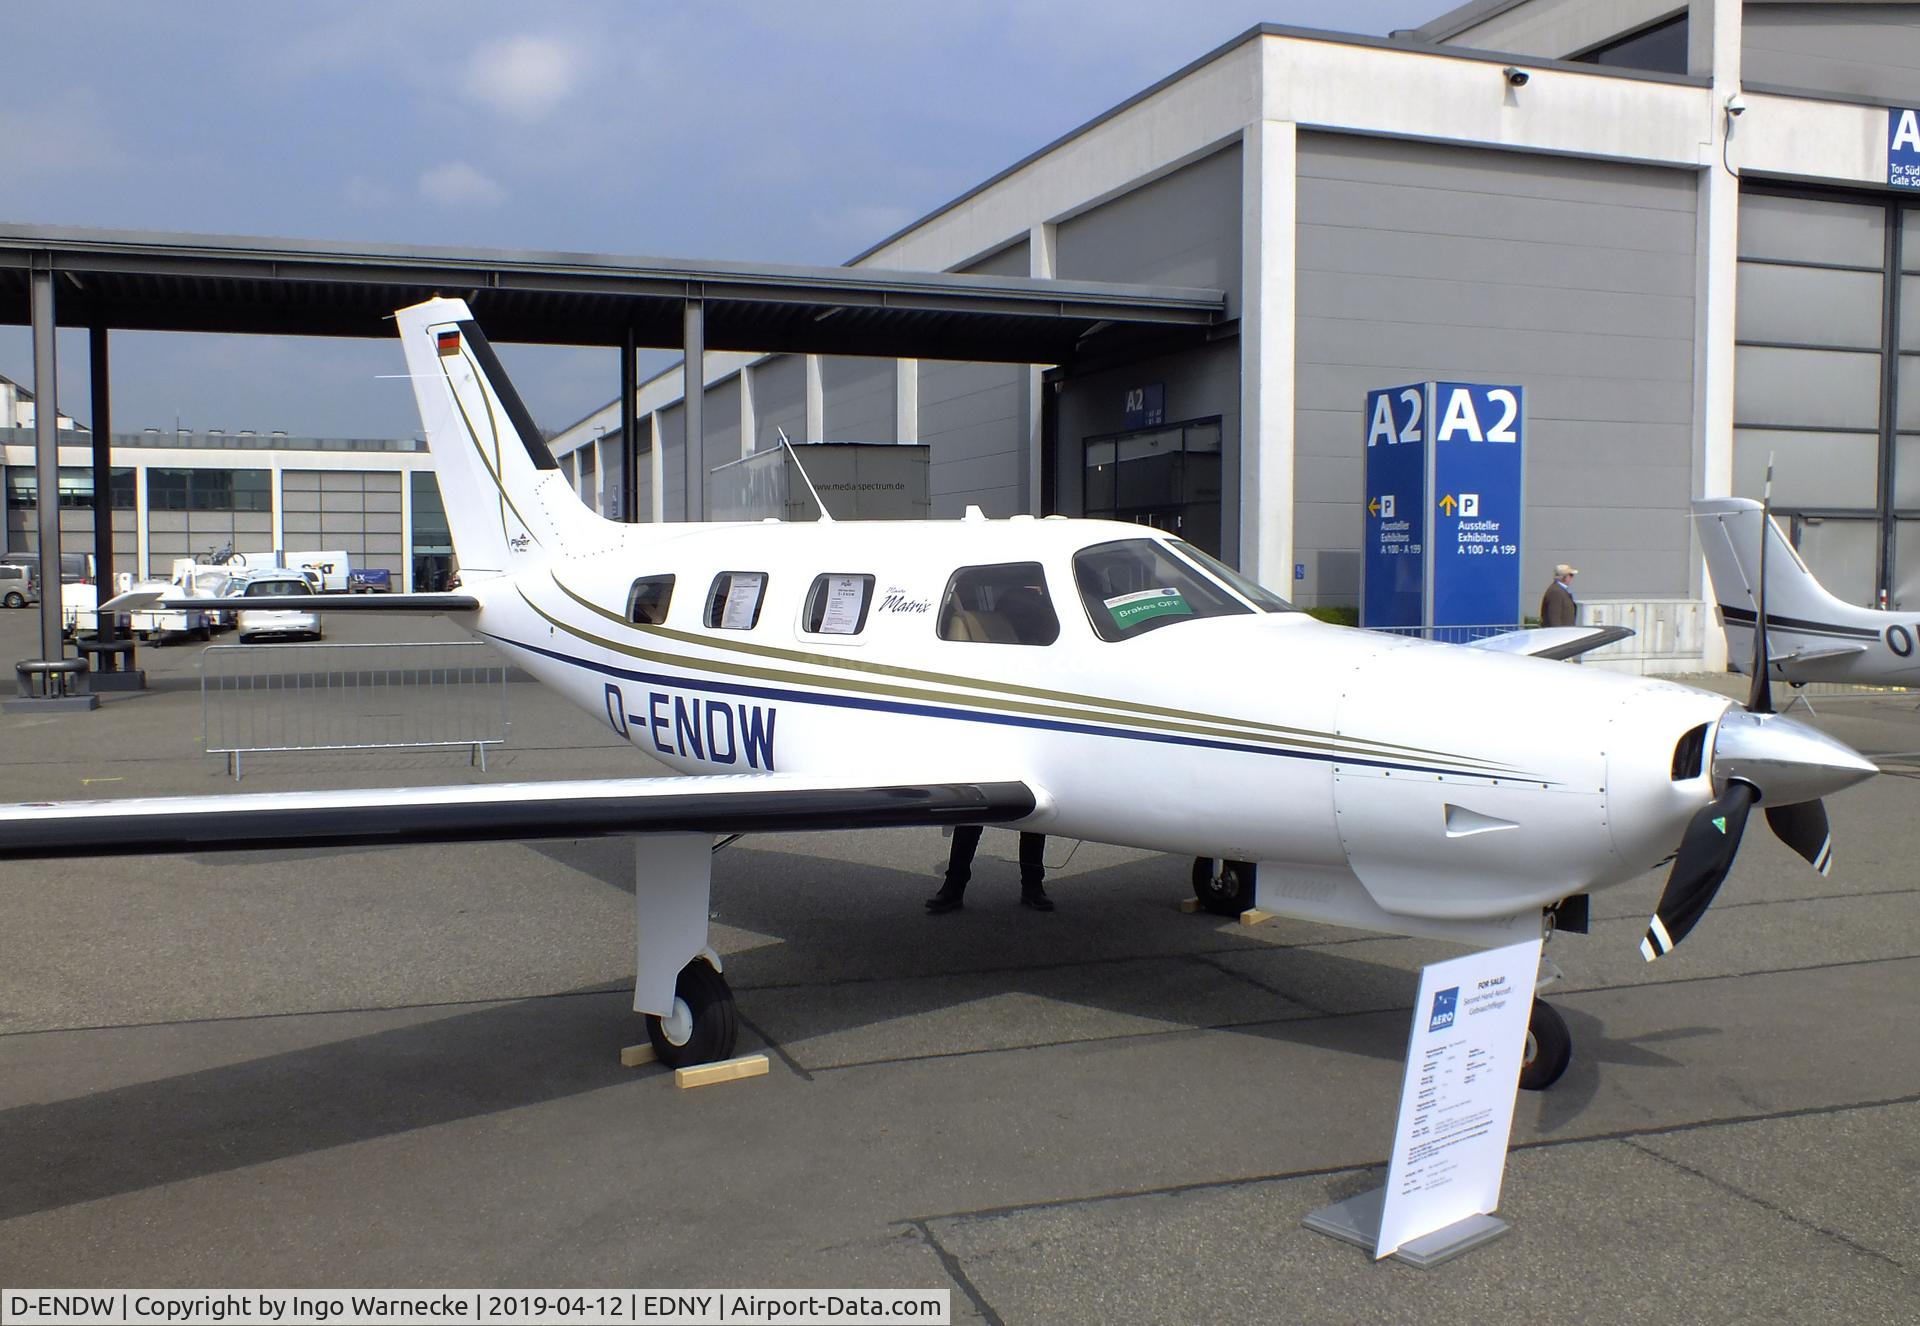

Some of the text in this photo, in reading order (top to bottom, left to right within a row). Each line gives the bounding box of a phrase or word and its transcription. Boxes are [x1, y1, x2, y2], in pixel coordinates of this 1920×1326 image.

[1891, 164, 1920, 176] Tor Süd
[1891, 175, 1909, 185] Gate
[1126, 388, 1144, 412] A2
[1368, 389, 1422, 447] A2
[1437, 388, 1518, 443] A2
[1464, 498, 1474, 513] P
[1458, 520, 1500, 531] Aussteller
[1458, 533, 1499, 542] Exhibitors
[1381, 545, 1387, 554] A
[1403, 545, 1409, 554] A
[1458, 545, 1465, 554] A
[1467, 545, 1484, 554] 100
[1491, 545, 1499, 554] A
[1500, 545, 1516, 554] 199
[879, 595, 931, 613] Matrix
[1119, 600, 1179, 618] Brakes OFF
[605, 683, 776, 772] D-ENDW
[1477, 980, 1490, 989] FOR
[1431, 1012, 1454, 1026] AERO
